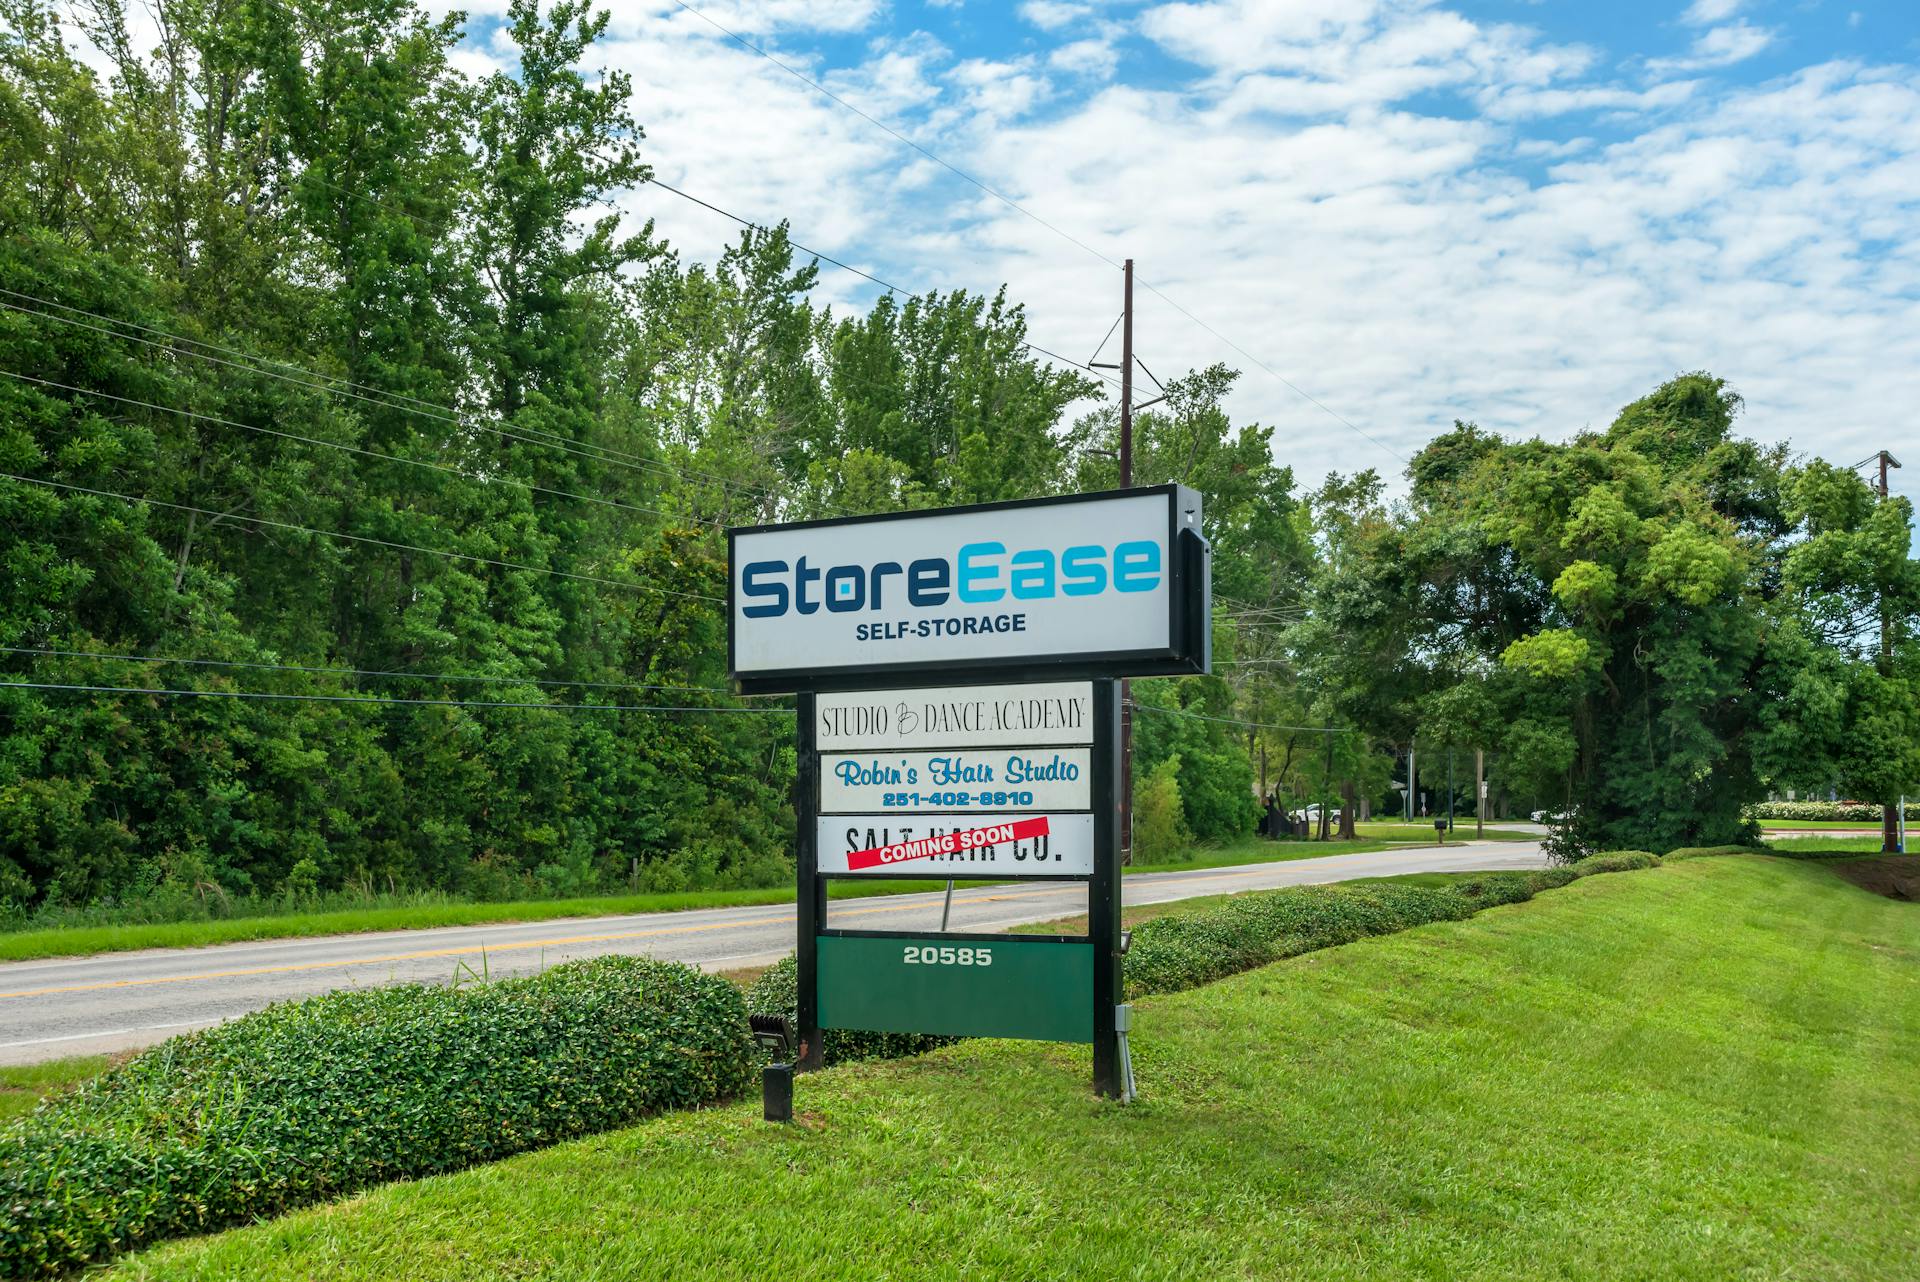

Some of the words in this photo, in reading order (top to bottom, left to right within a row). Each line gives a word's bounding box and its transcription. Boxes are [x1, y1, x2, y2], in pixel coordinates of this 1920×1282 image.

[742, 540, 1161, 618] StoreEase
[856, 613, 1026, 641] SELF-STORAGE
[822, 705, 888, 737] STUDIO
[924, 701, 985, 733] DANCE
[990, 697, 1085, 731] ACADEMY
[834, 759, 918, 787] Robin's
[928, 757, 994, 786] Hair
[1005, 755, 1079, 784] Studio
[882, 791, 1034, 807] 251-402-8910
[879, 835, 955, 863] COMING
[959, 823, 1015, 848] SOON
[903, 946, 992, 967] 20585
